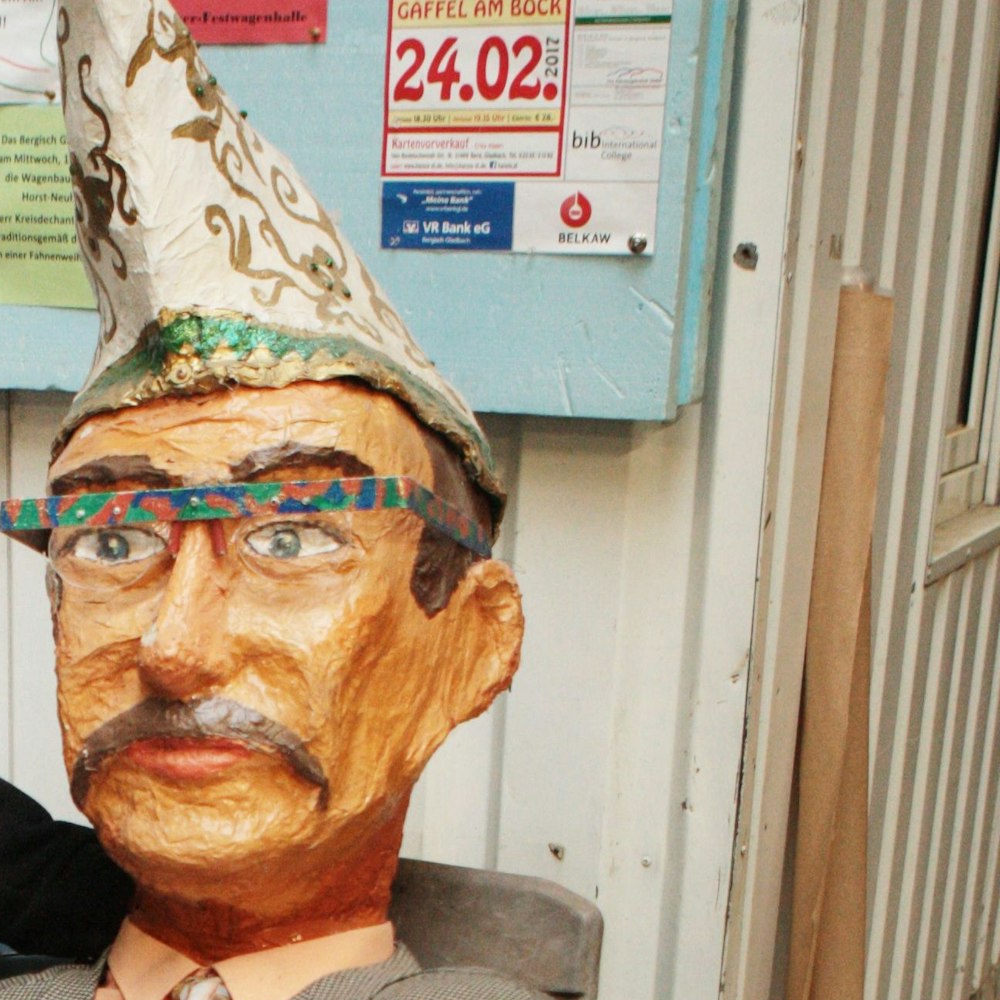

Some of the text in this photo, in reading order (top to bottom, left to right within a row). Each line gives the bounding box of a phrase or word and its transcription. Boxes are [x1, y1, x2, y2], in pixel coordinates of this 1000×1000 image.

[397, 1, 468, 20] GAFFEL
[474, 0, 503, 18] AM
[510, 0, 562, 17] BOCK
[544, 36, 560, 78] 2017
[393, 35, 559, 102] 24.02.
[1, 136, 17, 145] Das
[19, 135, 57, 147] Bergisch
[391, 138, 470, 150] Kartenvorverkauf
[571, 130, 601, 149] bib
[14, 154, 61, 165] Mittwoch,
[4, 173, 19, 183] die
[422, 221, 491, 235] VR Bank eG
[558, 232, 612, 244] BELKAW
[5, 251, 27, 260] einer
